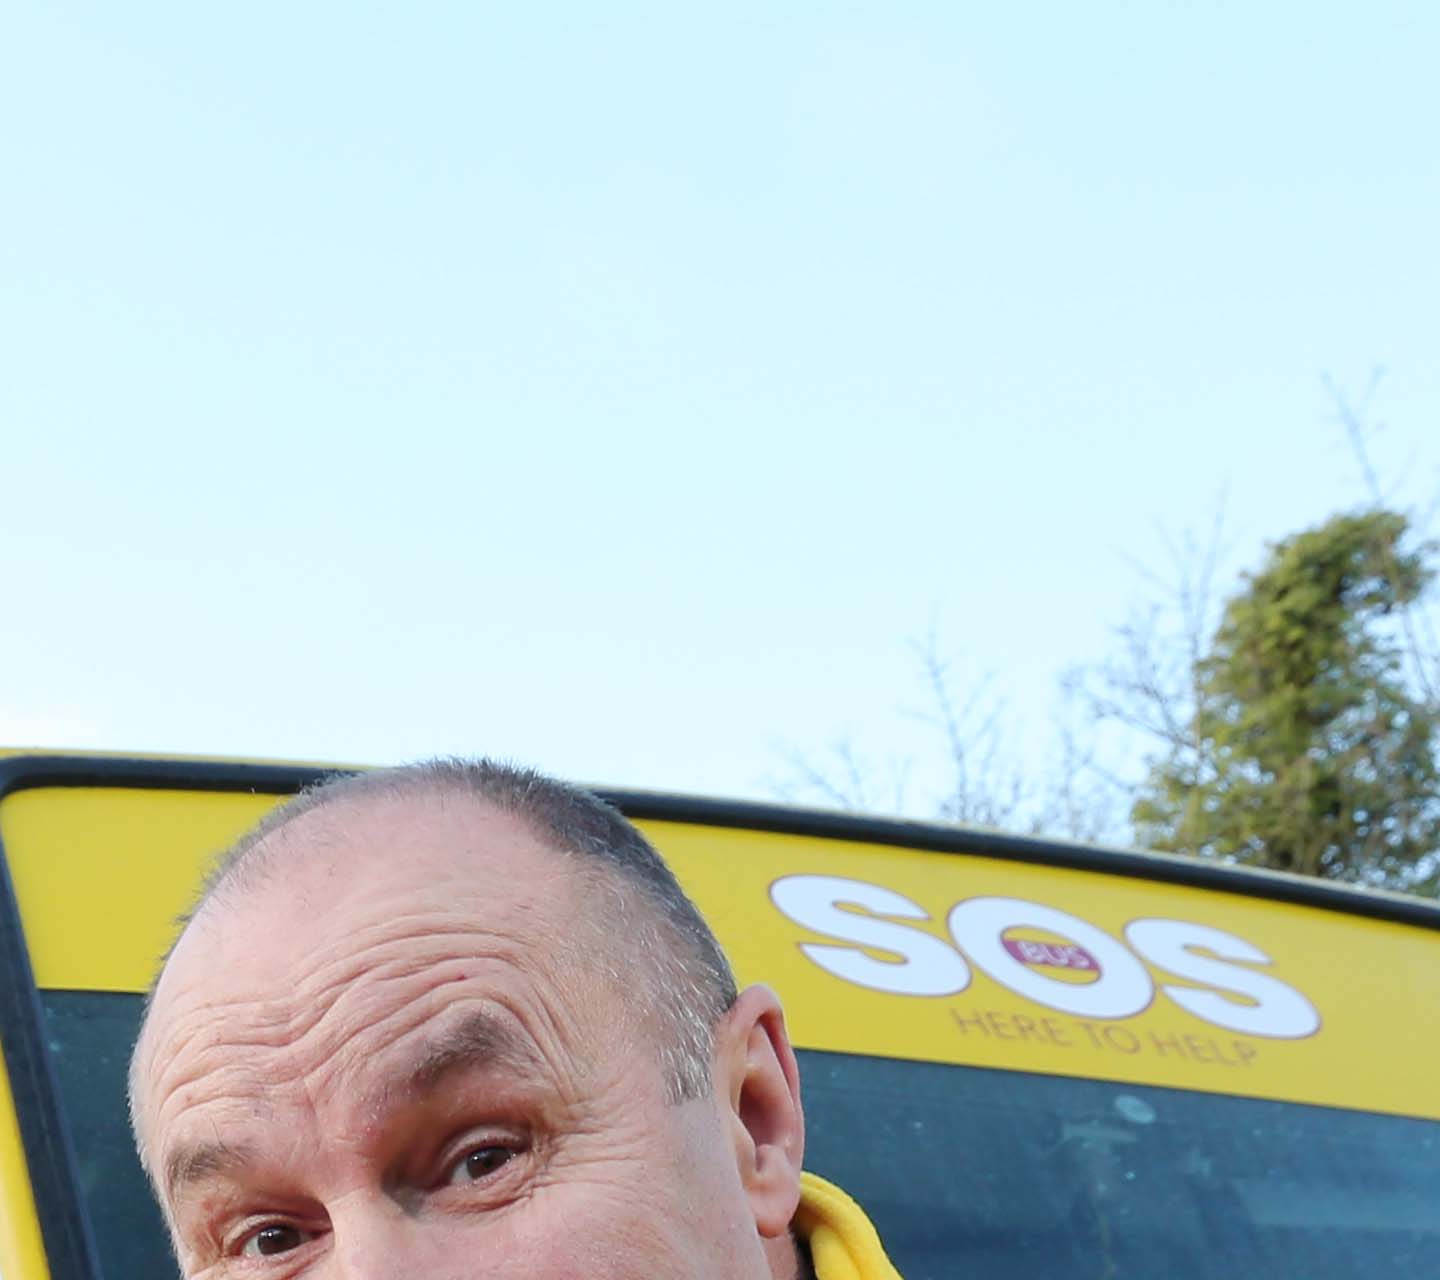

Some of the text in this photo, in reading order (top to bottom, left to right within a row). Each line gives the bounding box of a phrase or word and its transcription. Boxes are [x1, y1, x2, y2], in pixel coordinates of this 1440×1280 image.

[768, 874, 1322, 1040] SOS
[1016, 938, 1094, 969] BUS
[951, 1008, 1259, 1070] HERE TO HELP
